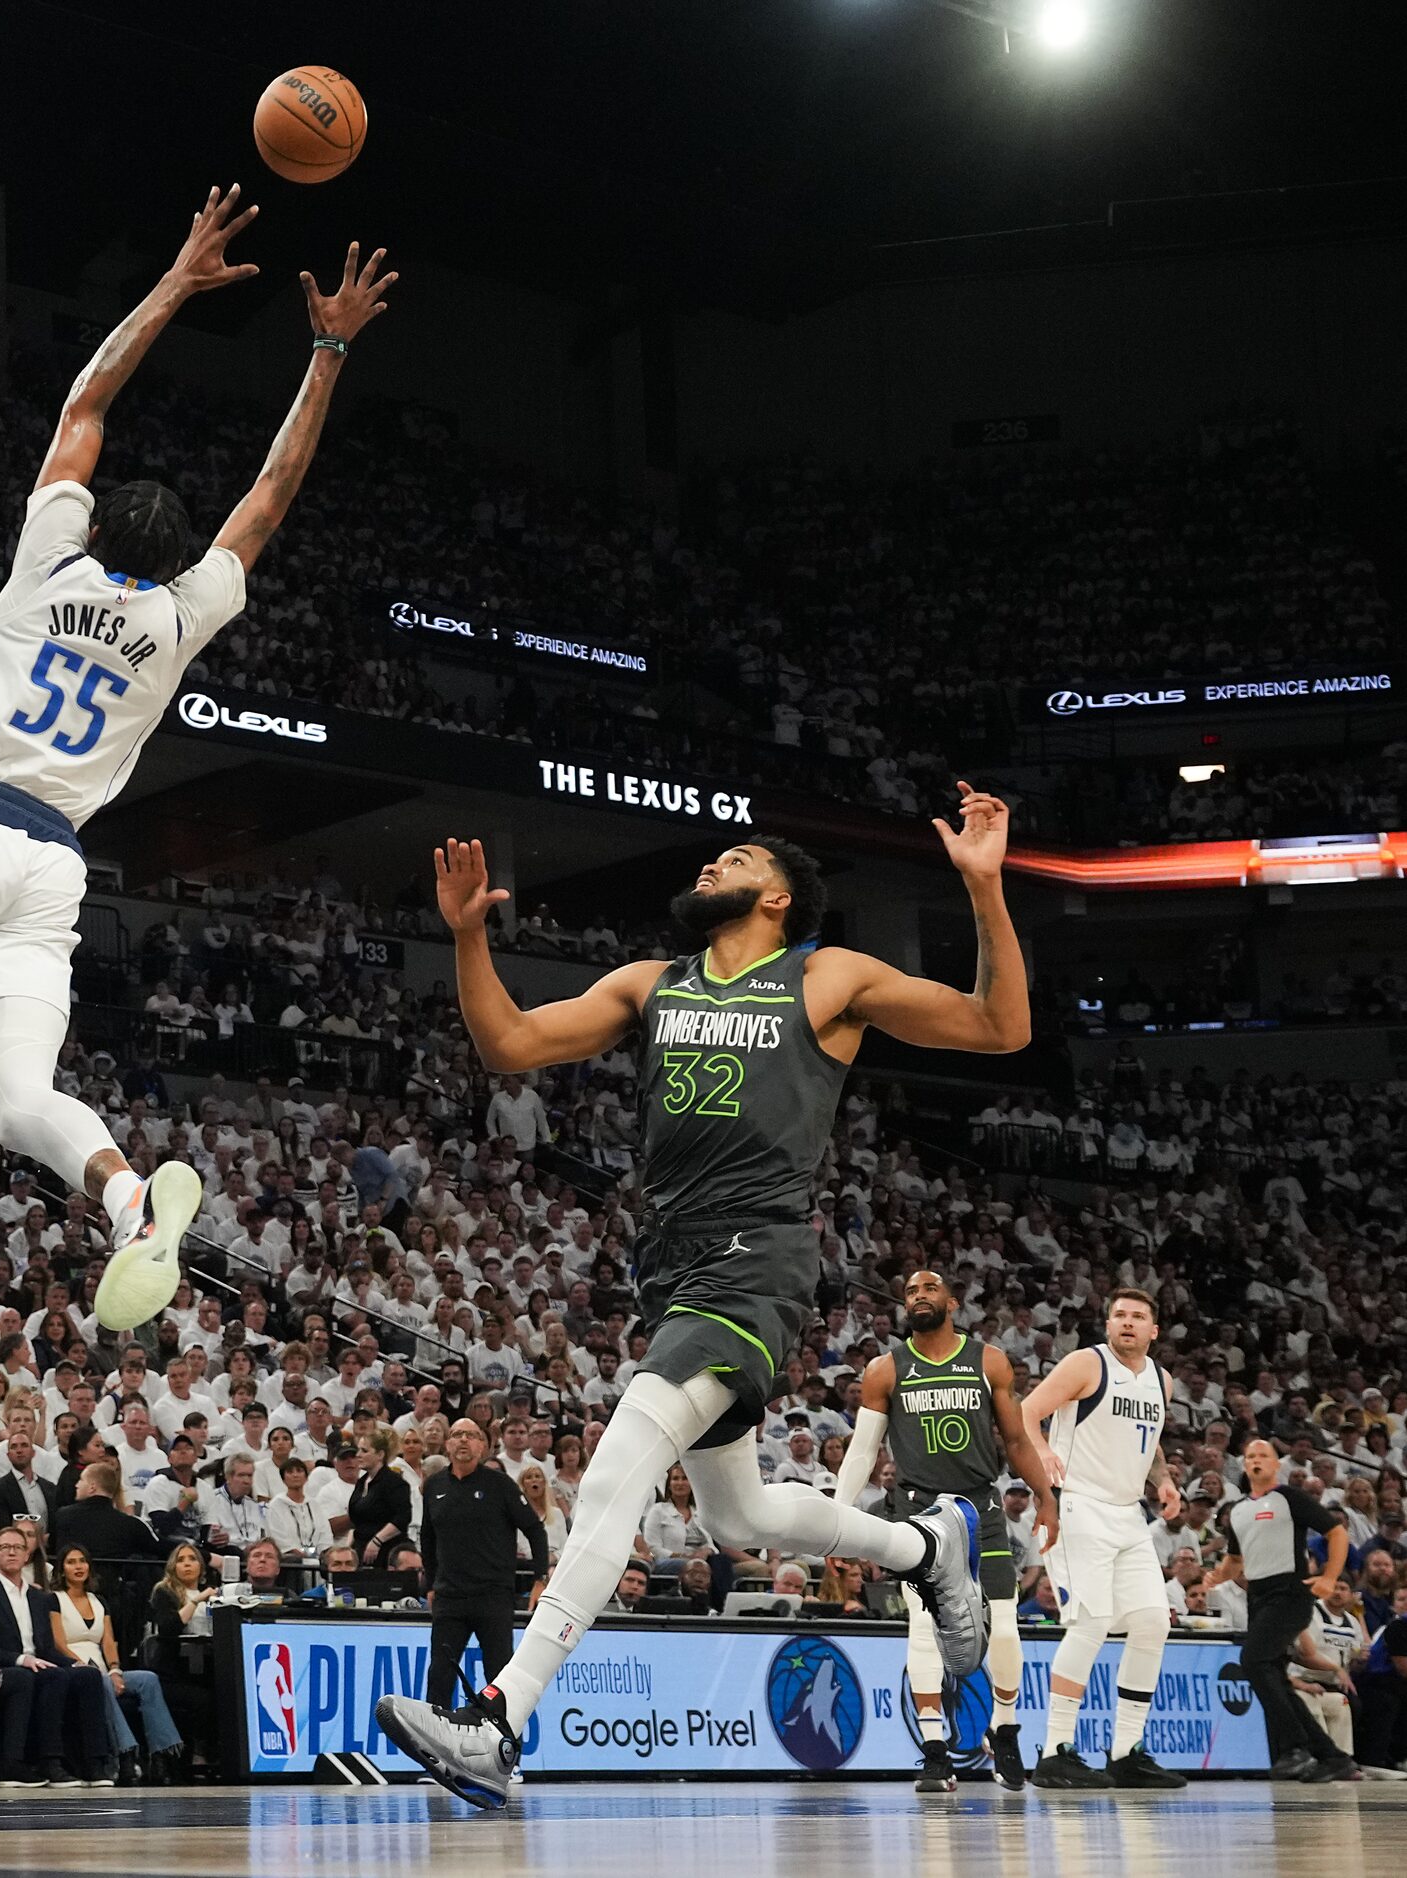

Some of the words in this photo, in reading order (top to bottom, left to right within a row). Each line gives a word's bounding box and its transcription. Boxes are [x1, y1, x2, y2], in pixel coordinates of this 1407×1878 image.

[48, 603, 125, 645] JONES
[120, 633, 157, 673] JR.
[591, 648, 647, 672] AMAZING
[9, 639, 130, 756] 55
[1086, 689, 1187, 709] LEXUS
[1205, 680, 1310, 702] EXPERIENCE
[1312, 674, 1391, 694] AMAZING
[220, 706, 328, 743] LEXUS
[538, 760, 595, 797] THE
[607, 772, 701, 815] LEXUS
[710, 791, 753, 825] GX
[358, 941, 388, 964] 133
[655, 1009, 783, 1054] TIMBERWOLVES
[663, 1050, 745, 1118] 32
[900, 1387, 982, 1415] TIMBERWOLVES
[1112, 1396, 1160, 1422] DALLAS
[920, 1414, 971, 1454] 10
[556, 1655, 632, 1694] Presented
[634, 1655, 651, 1701] by
[1192, 1673, 1211, 1712] ET
[1217, 1680, 1253, 1702] TNT
[873, 1688, 892, 1719] VS
[263, 1732, 283, 1751] NBA
[560, 1707, 679, 1758] Google
[686, 1709, 757, 1747] Pixel
[1074, 1719, 1099, 1753] AME
[1143, 1718, 1212, 1753] ECESSARY
